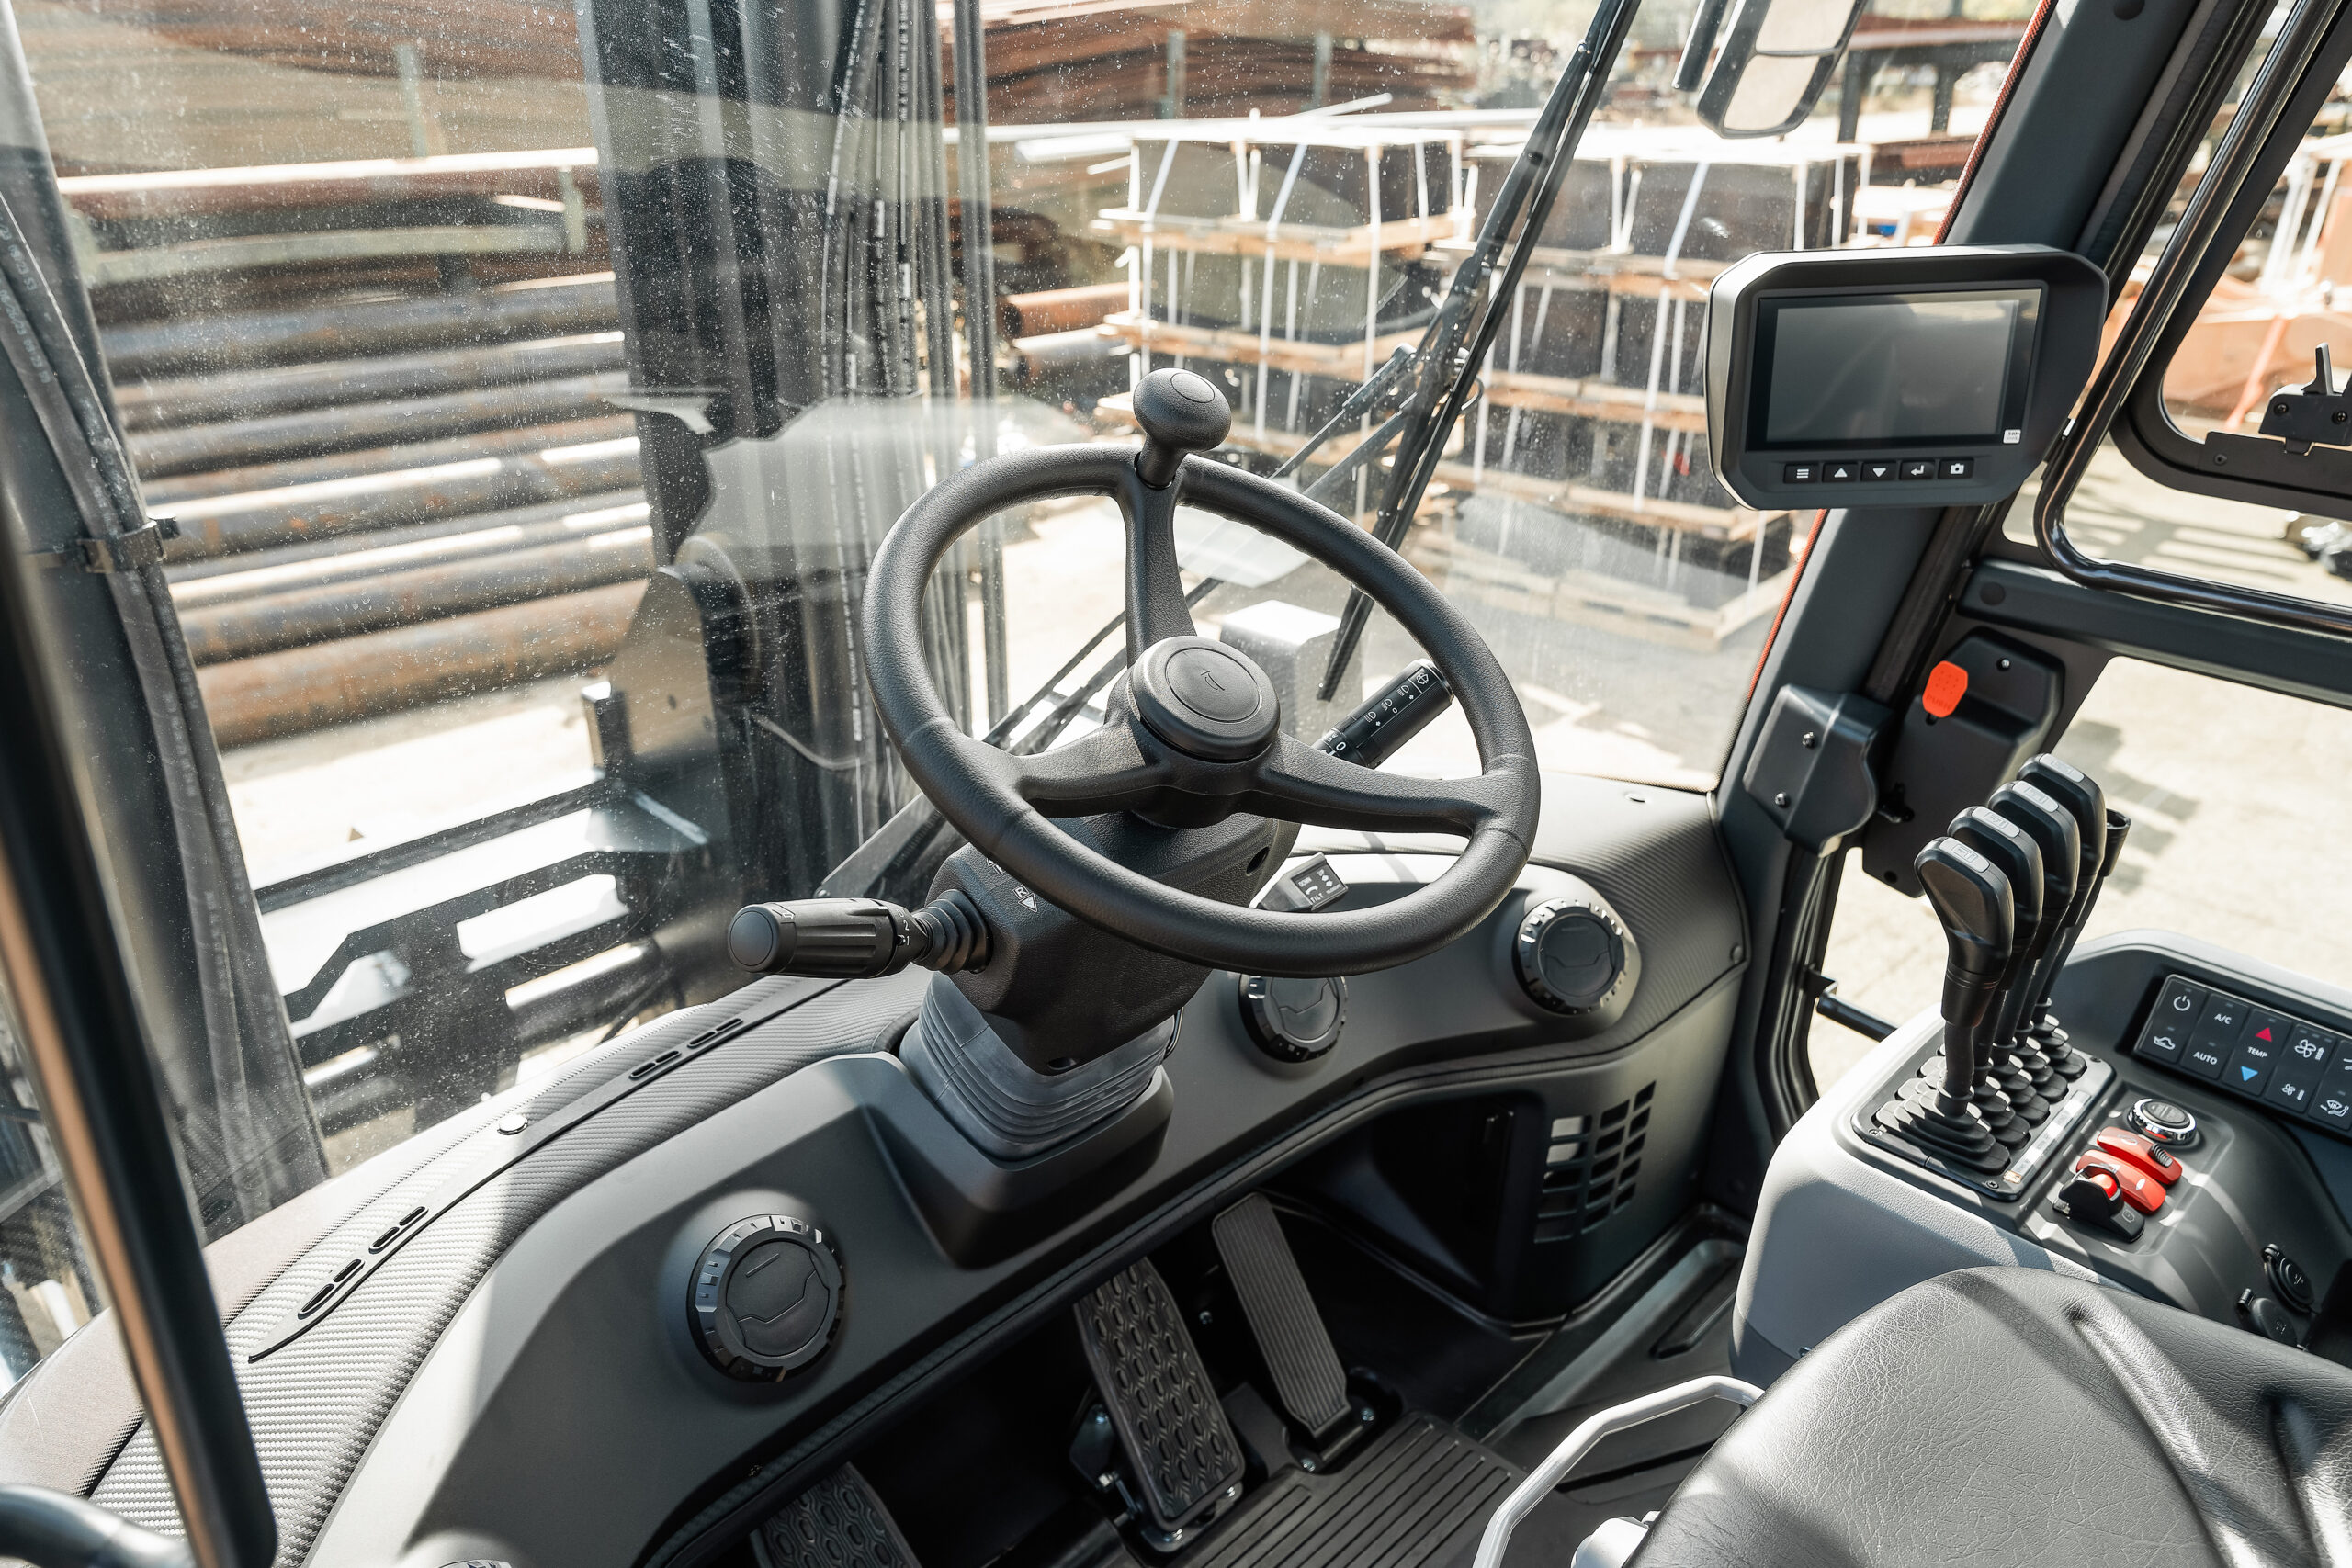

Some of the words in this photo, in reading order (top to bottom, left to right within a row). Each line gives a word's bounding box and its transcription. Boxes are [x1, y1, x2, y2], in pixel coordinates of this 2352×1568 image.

[1014, 886, 1028, 898] R
[1310, 892, 1324, 904] TILT
[903, 919, 910, 931] 2
[2214, 1013, 2232, 1025] A/C
[2193, 1051, 2218, 1065] AUTO
[2247, 1046, 2267, 1058] TEMP
